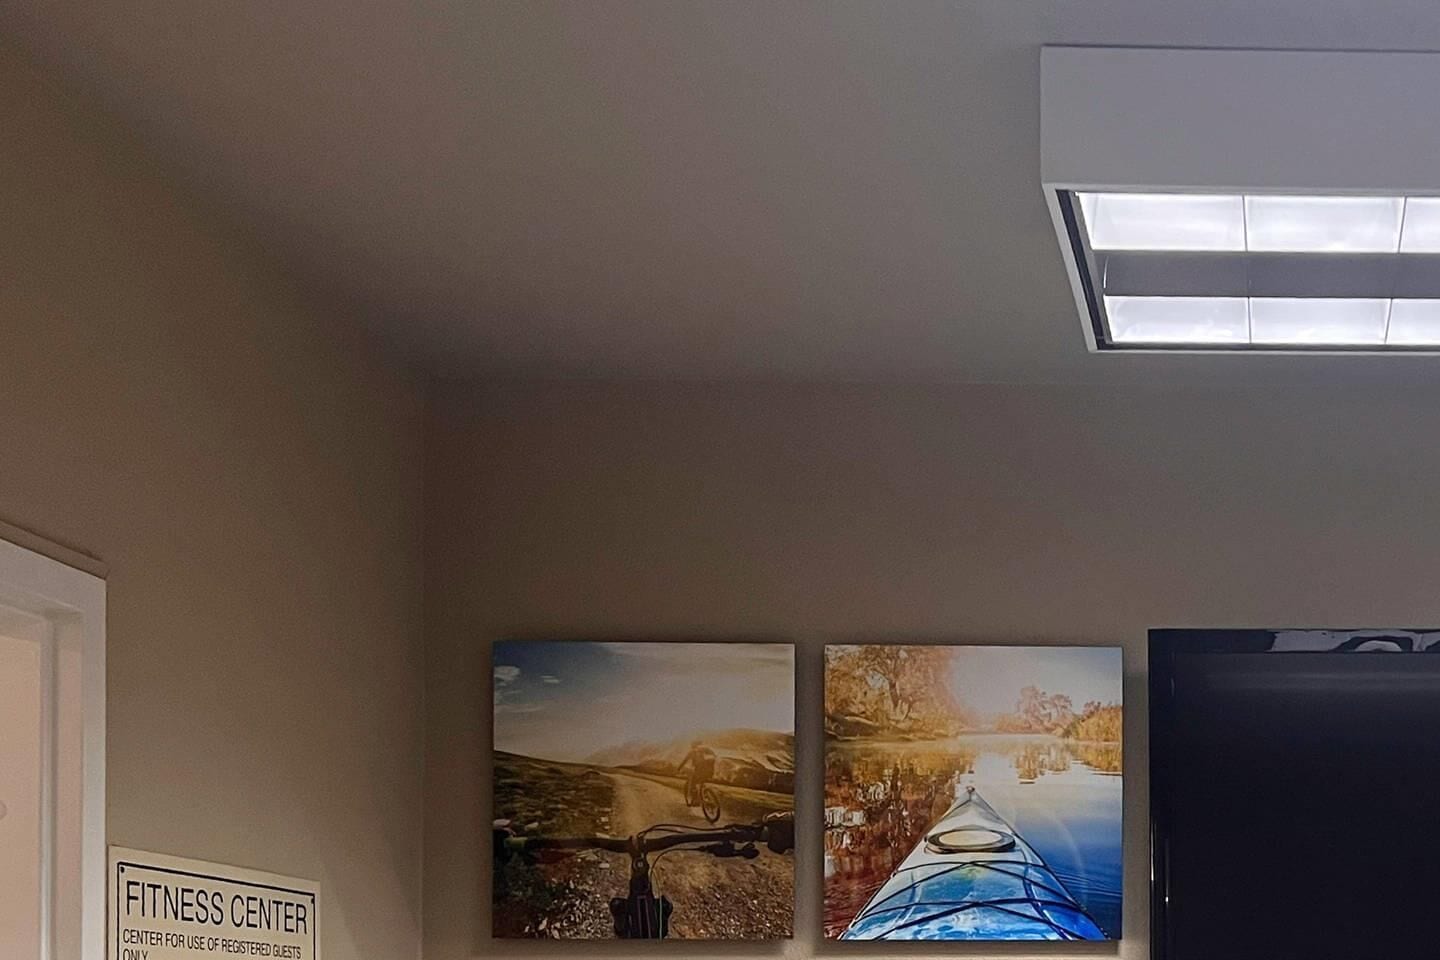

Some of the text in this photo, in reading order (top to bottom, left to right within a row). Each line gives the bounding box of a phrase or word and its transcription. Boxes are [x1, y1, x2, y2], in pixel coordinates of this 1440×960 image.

[126, 880, 307, 935] FITNESS CENTER
[122, 928, 302, 960] CENTER FOR USE OF REGISTERED GUESTS
